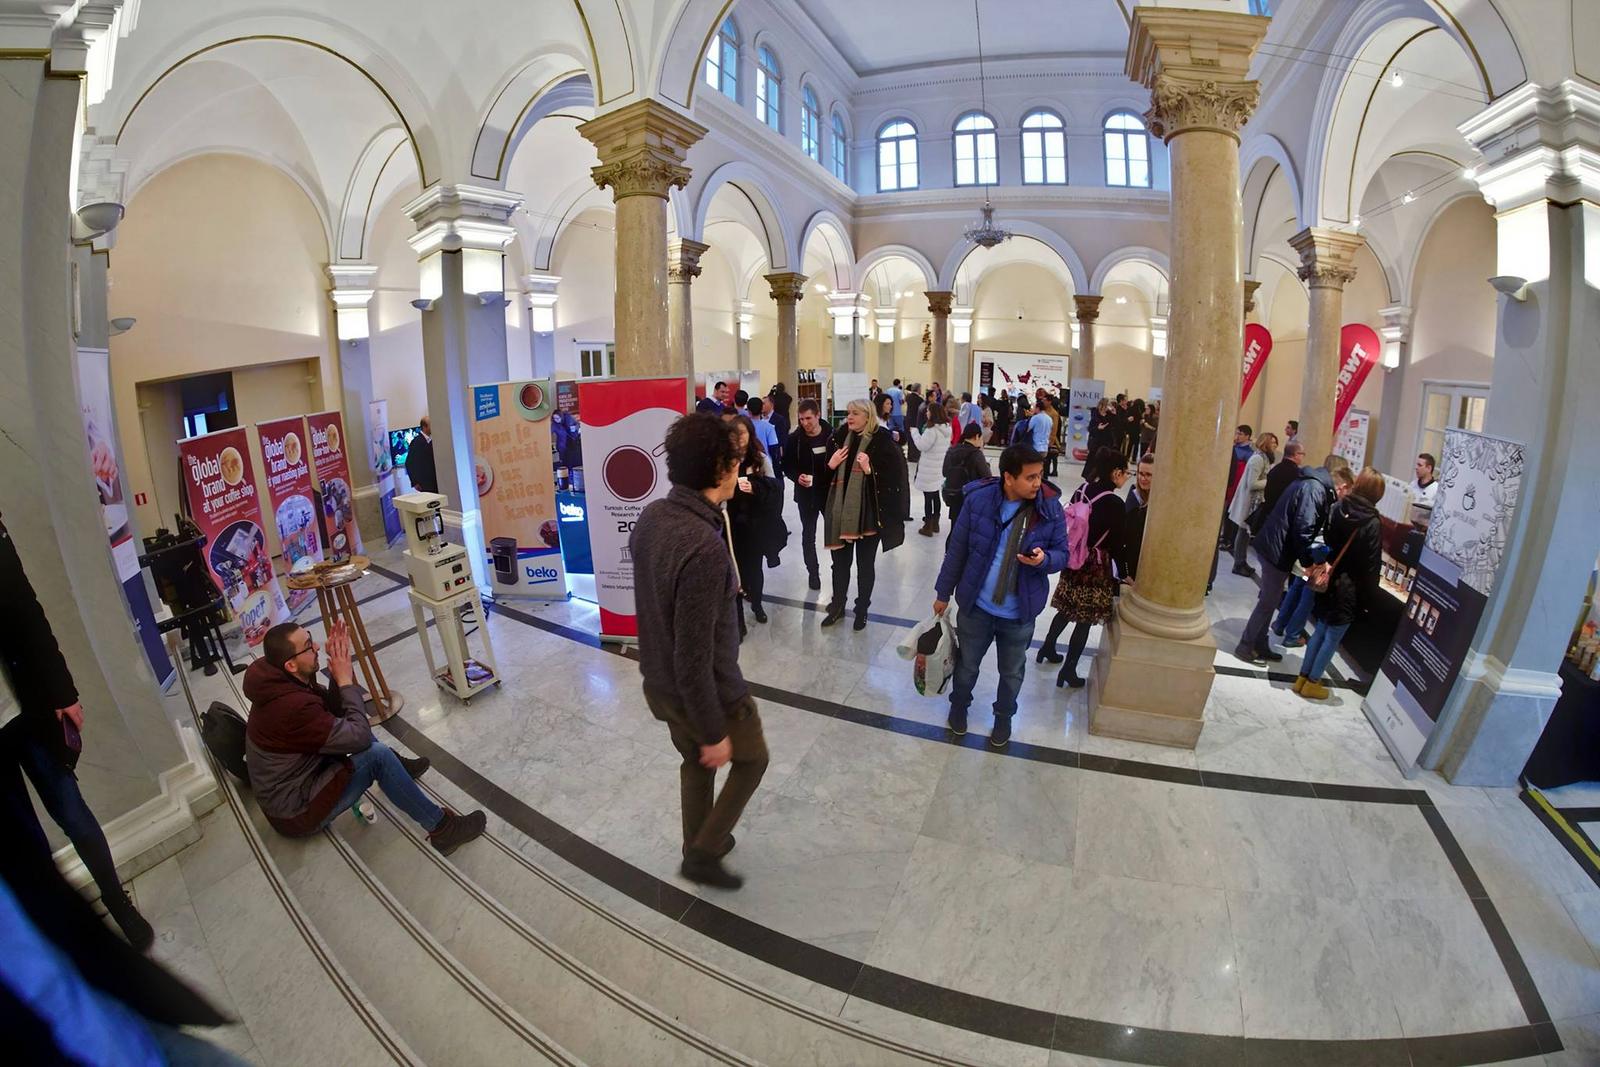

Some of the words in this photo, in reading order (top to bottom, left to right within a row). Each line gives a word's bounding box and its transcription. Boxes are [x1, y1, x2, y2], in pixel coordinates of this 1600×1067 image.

[1339, 342, 1368, 385] BWT
[1073, 390, 1100, 400] INKER
[264, 436, 285, 463] global
[479, 429, 511, 453] Dan
[187, 454, 197, 466] the
[191, 453, 221, 486] global
[270, 458, 287, 473] brand
[201, 478, 226, 498] brand
[203, 499, 212, 513] at
[210, 495, 225, 513] your
[224, 488, 241, 504] coffee
[240, 484, 254, 497] shop
[505, 503, 545, 521] kave
[560, 502, 584, 517] beko
[525, 565, 558, 578] beko
[239, 595, 266, 629] Toper
